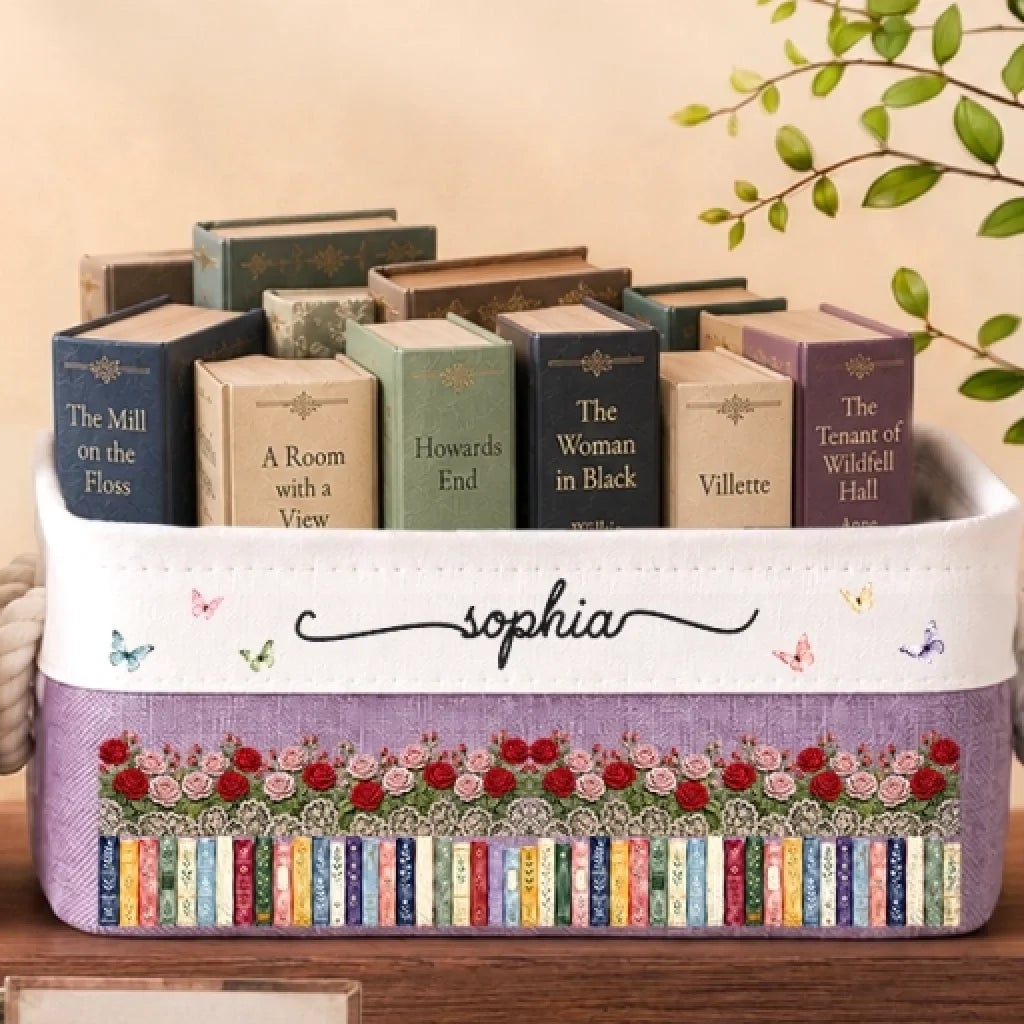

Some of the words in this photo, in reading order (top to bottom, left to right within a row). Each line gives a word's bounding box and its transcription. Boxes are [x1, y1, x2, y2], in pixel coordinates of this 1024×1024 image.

[66, 403, 103, 429] The
[107, 407, 146, 433] Mill
[577, 400, 617, 423] The
[841, 396, 877, 417] The
[816, 425, 878, 445] Tenant
[883, 420, 904, 443] of
[77, 444, 101, 461] on
[106, 441, 135, 464] the
[415, 435, 503, 459] Howards
[556, 433, 636, 456] Woman
[261, 447, 278, 468] A
[285, 446, 345, 467] Room
[823, 449, 894, 474] Wildfell
[84, 471, 131, 496] Floss
[276, 479, 316, 499] with
[321, 484, 332, 497] a
[439, 469, 477, 491] End
[556, 469, 575, 491] in
[582, 464, 637, 491] Black
[699, 473, 771, 496] Villette
[839, 479, 877, 501] Hall
[278, 508, 329, 528] View
